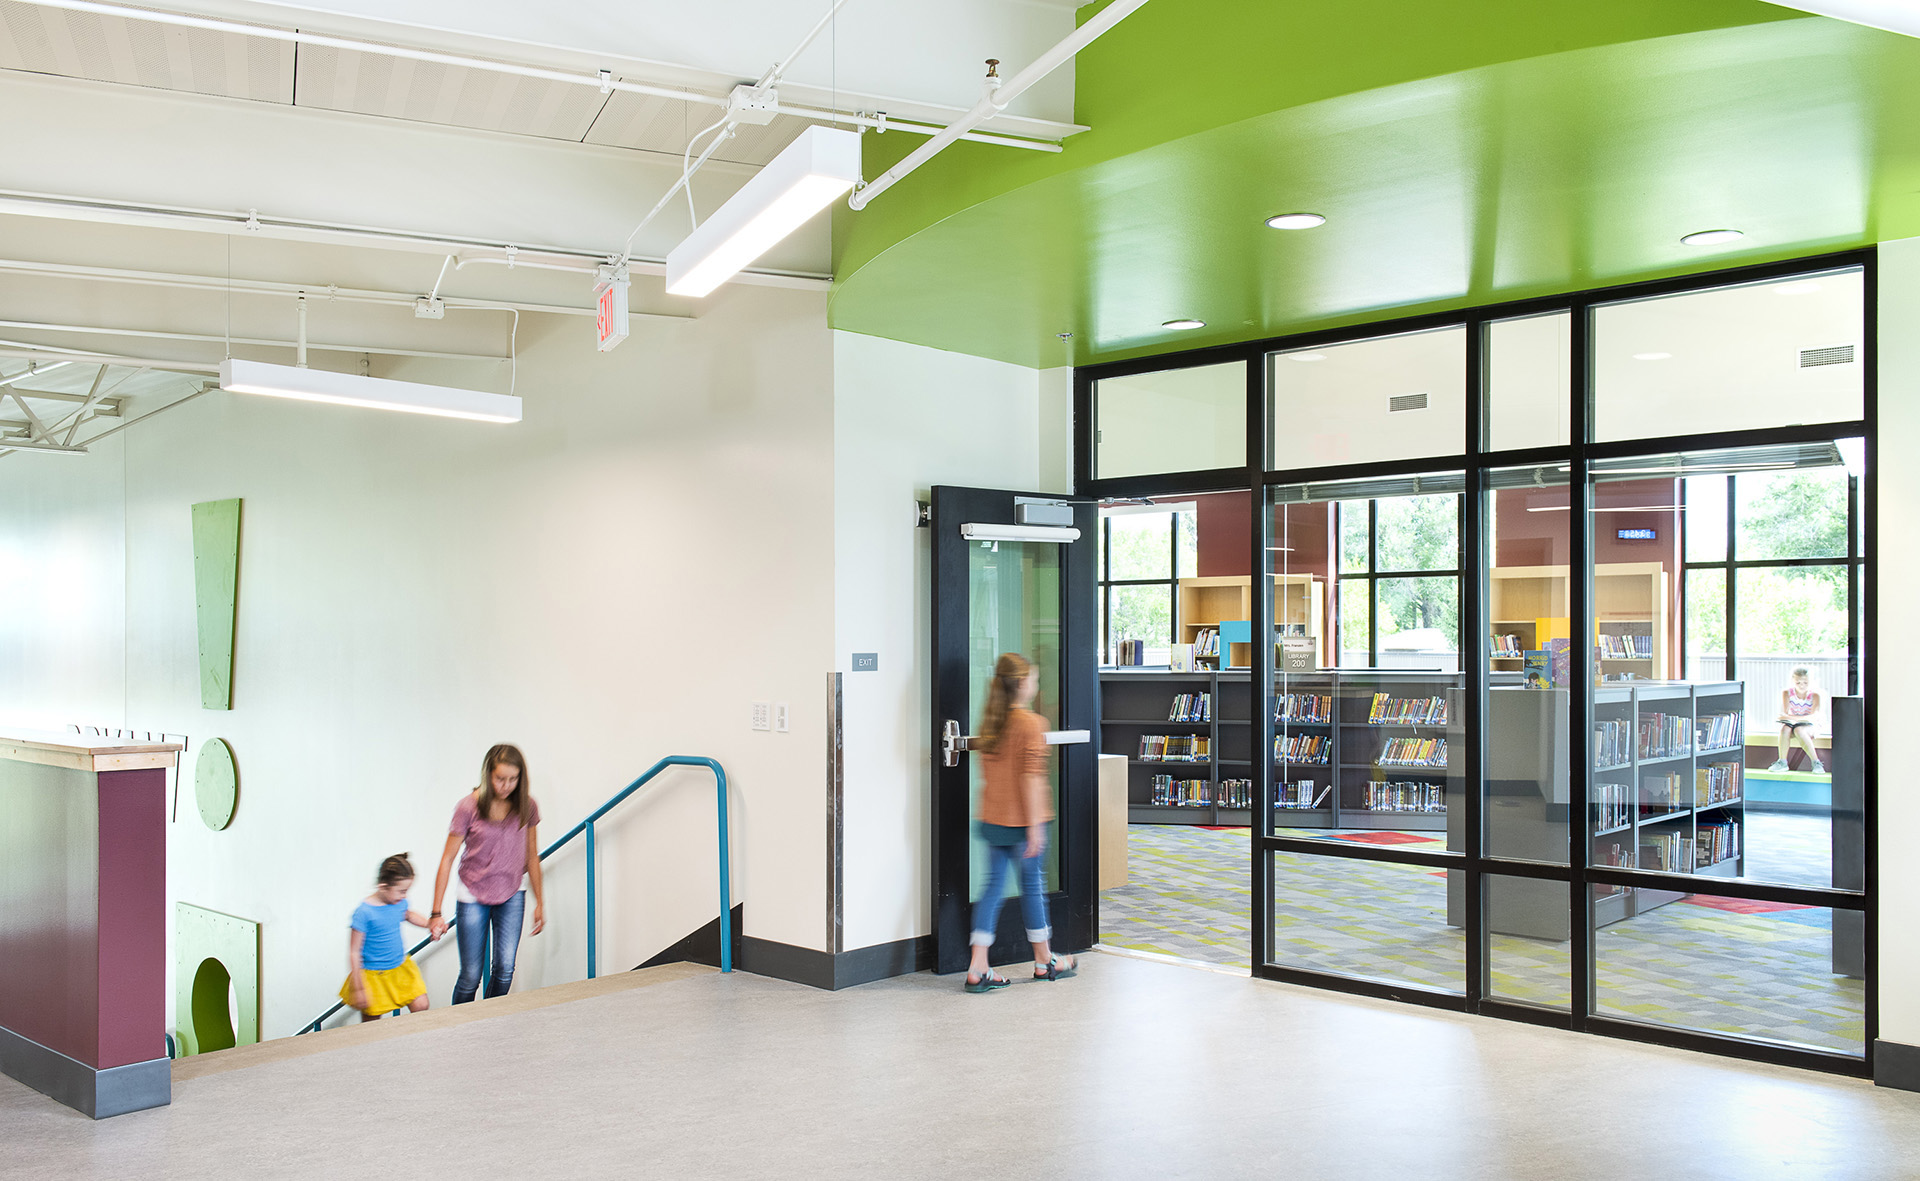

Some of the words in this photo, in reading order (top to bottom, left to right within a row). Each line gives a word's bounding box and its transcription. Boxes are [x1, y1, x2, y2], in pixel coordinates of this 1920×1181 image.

[600, 288, 613, 342] EXIT
[859, 658, 873, 666] EXIT
[1292, 659, 1306, 668] 200
